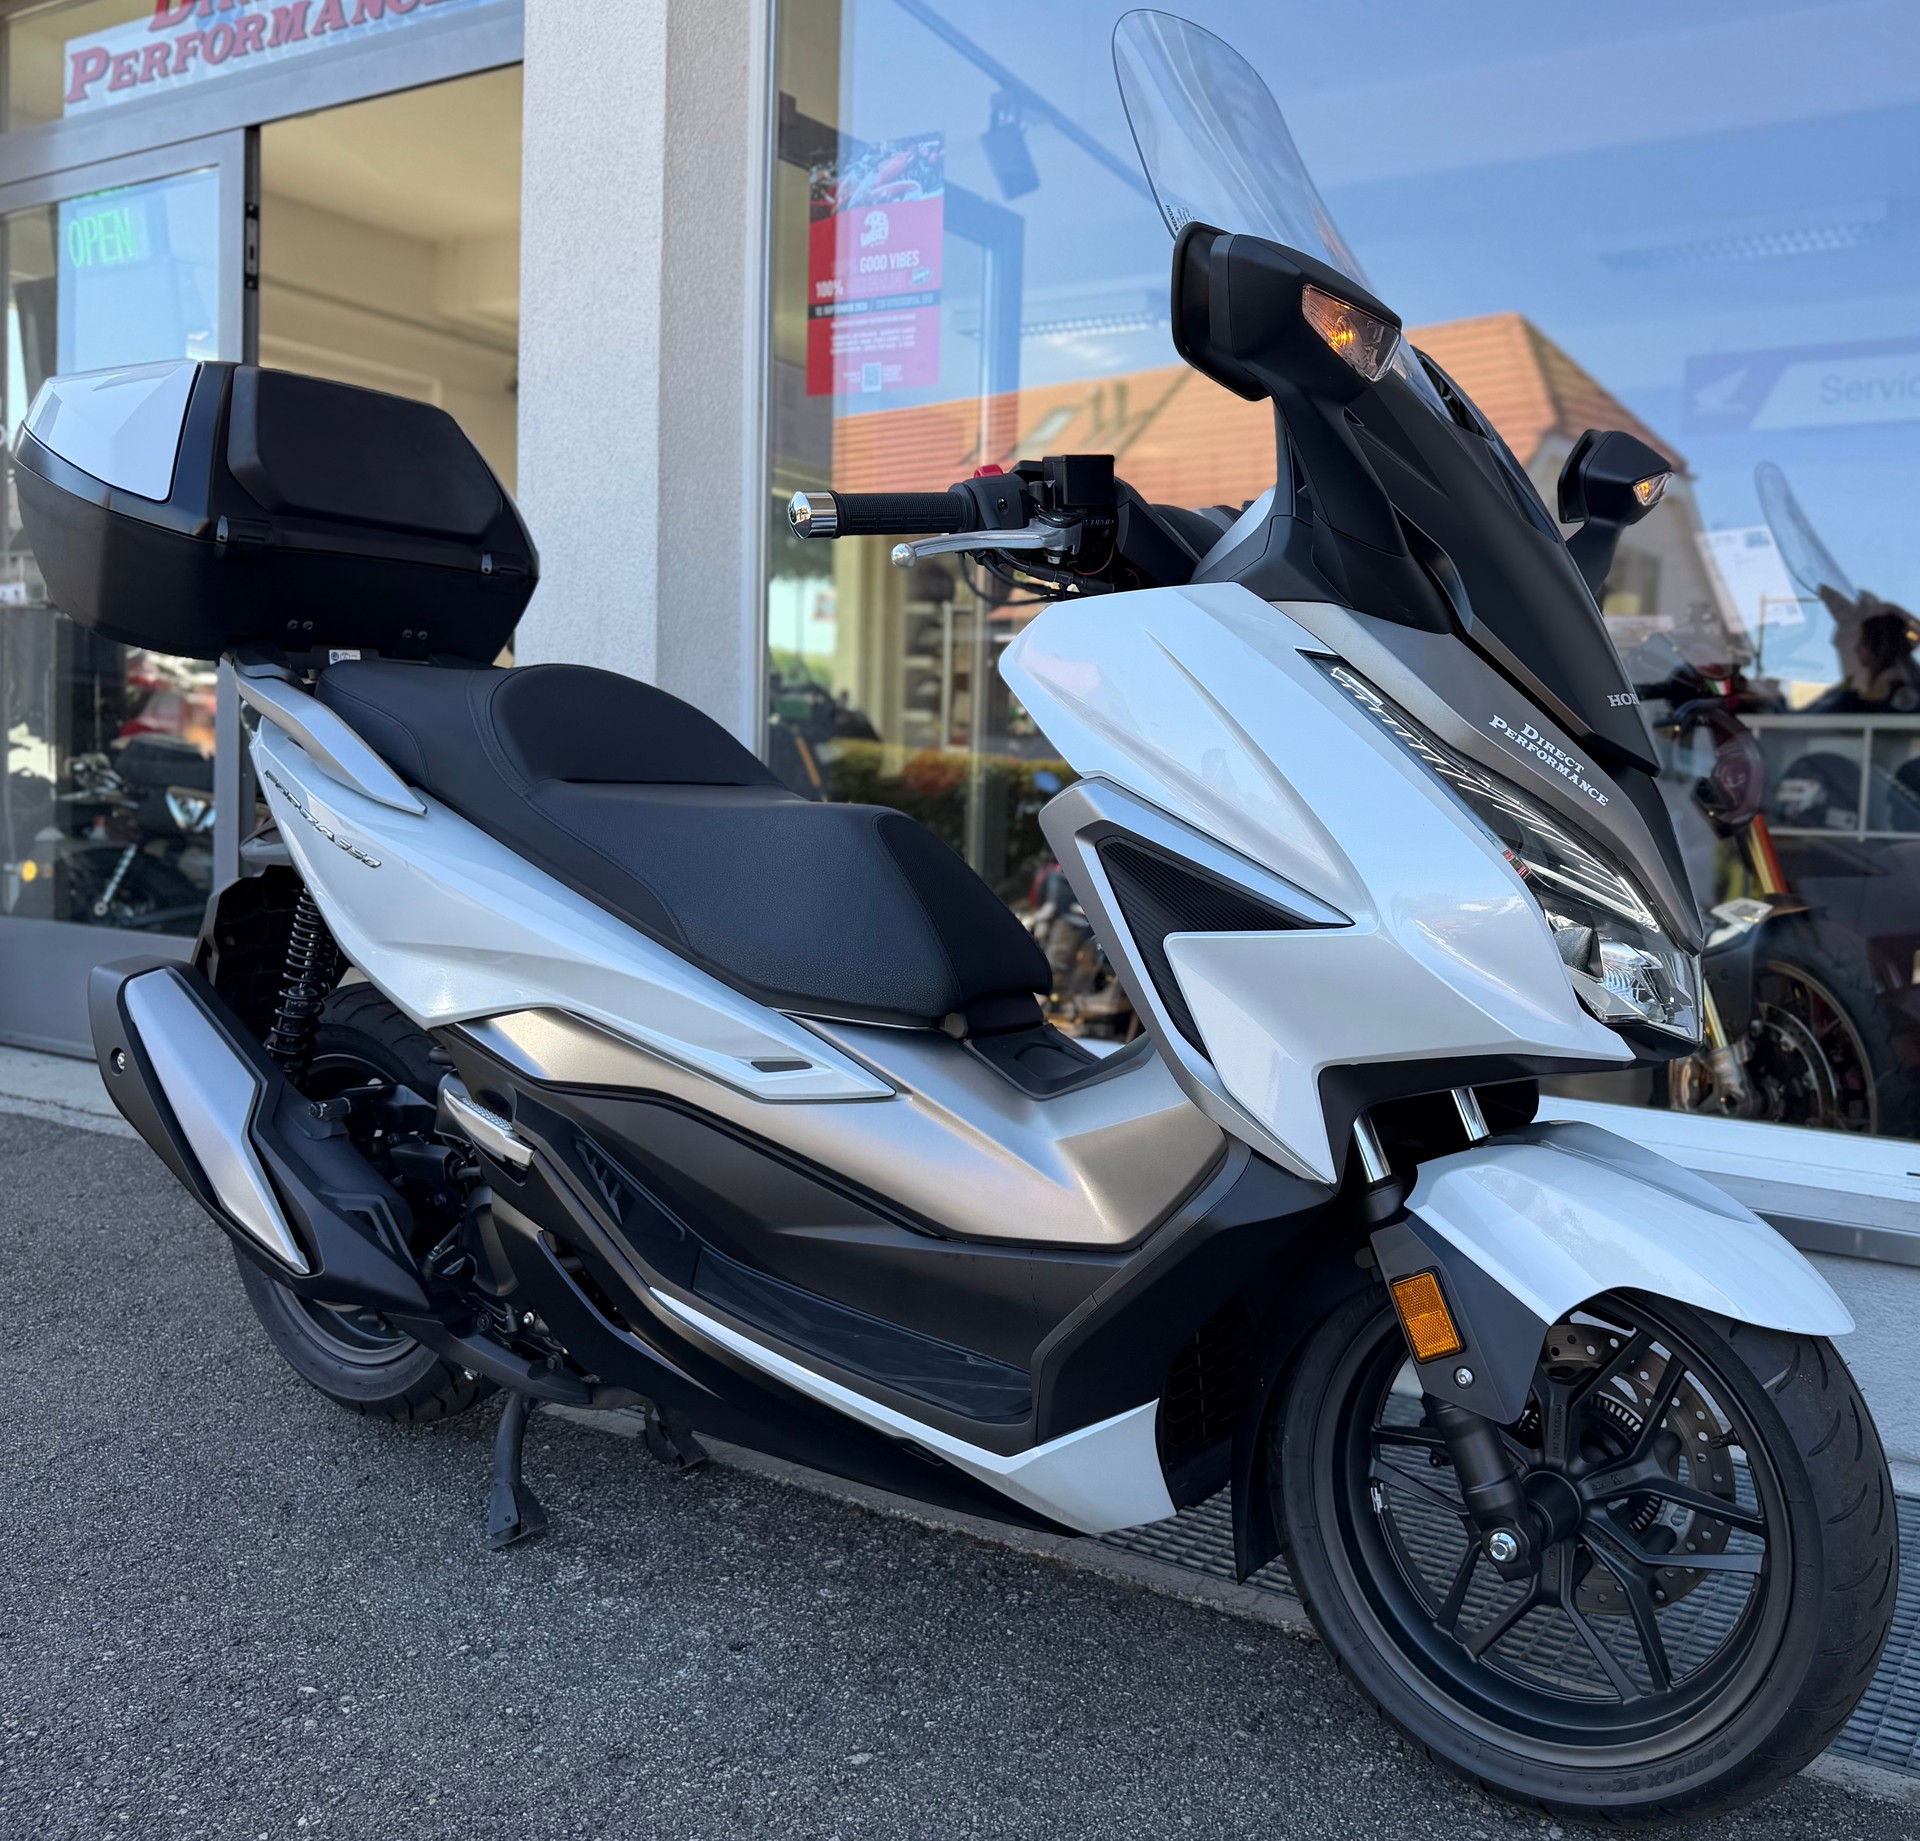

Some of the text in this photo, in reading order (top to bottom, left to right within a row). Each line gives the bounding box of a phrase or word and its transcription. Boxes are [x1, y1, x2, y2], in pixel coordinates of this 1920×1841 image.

[67, 207, 133, 268] OPEN
[860, 253, 888, 273] GOOD
[889, 249, 920, 270] VIBES
[815, 279, 843, 298] 100%
[1488, 714, 1609, 807] PERFORMANCE
[1520, 722, 1585, 774] DIRECT
